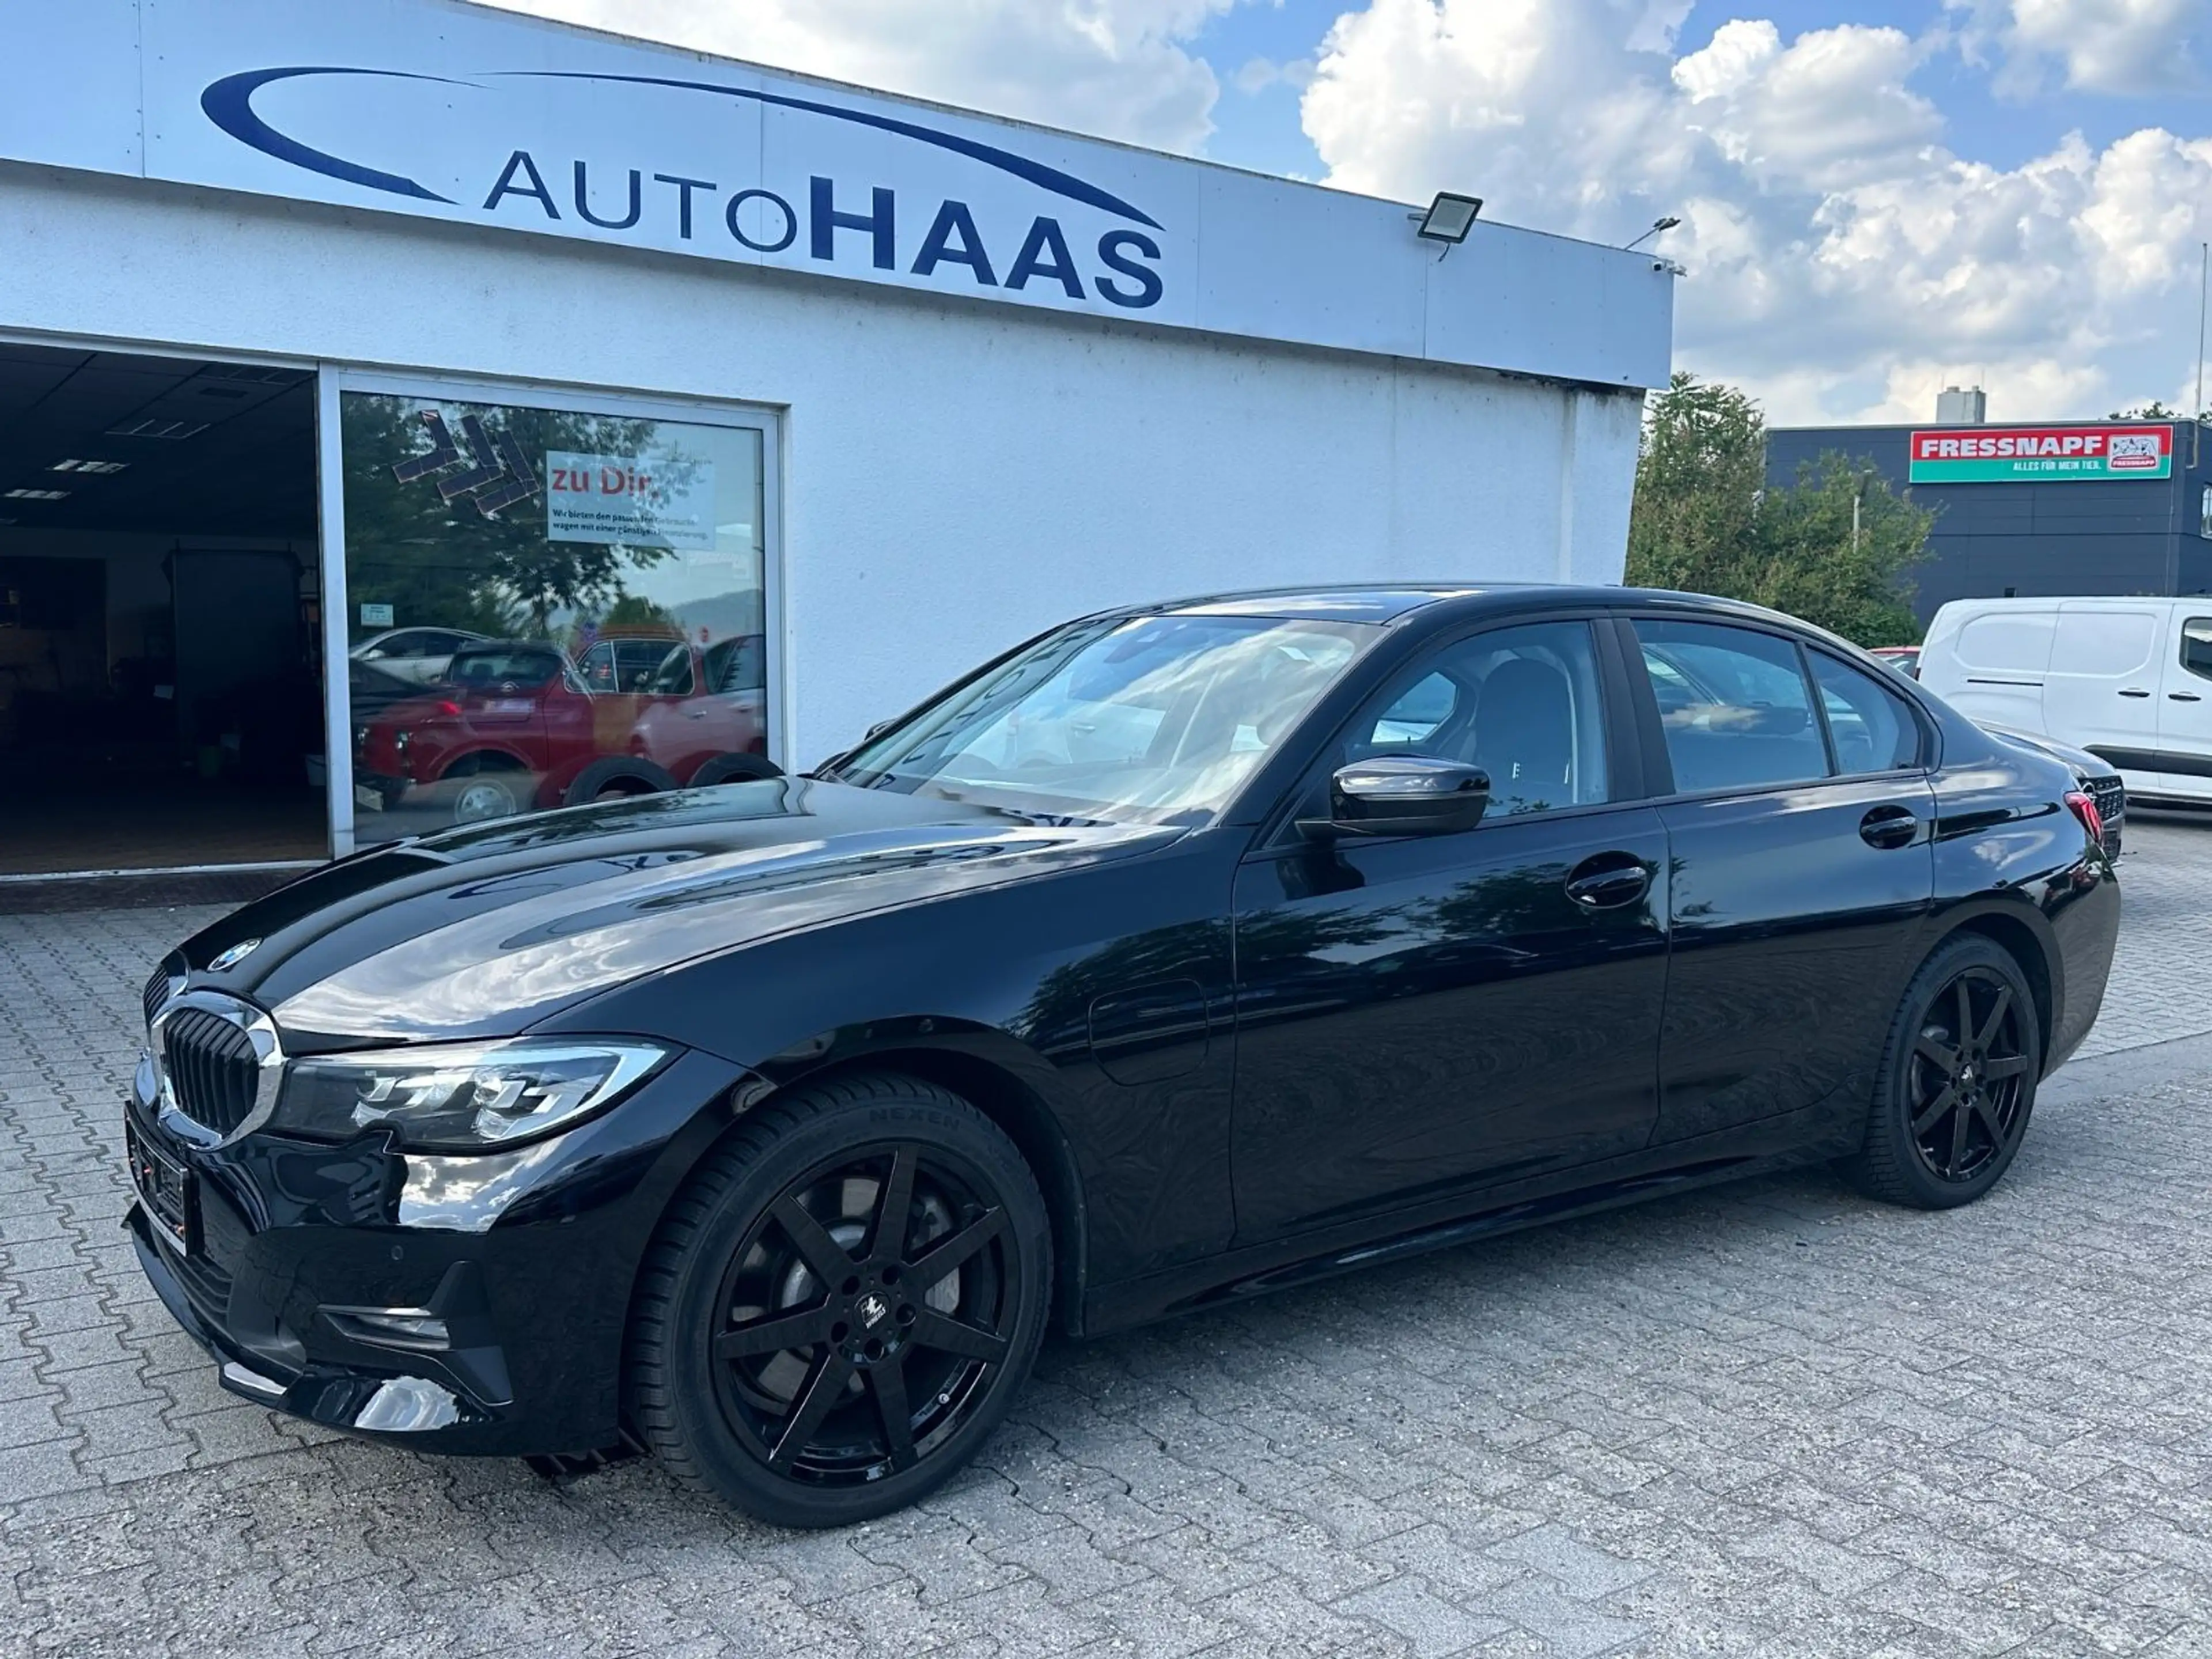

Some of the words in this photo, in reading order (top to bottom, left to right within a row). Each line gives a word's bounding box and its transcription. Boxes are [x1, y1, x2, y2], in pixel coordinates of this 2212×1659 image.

[1921, 435, 2103, 457] FRESSNAPF
[2013, 461, 2039, 471] ALLES
[2041, 459, 2056, 470] FÜR
[2058, 461, 2080, 470] MEIN
[552, 469, 589, 493] zu
[601, 466, 660, 500] Dir.
[552, 508, 567, 517] Wir
[567, 509, 594, 518] bieten
[596, 511, 611, 520] den
[552, 522, 579, 531] wagen
[869, 1107, 960, 1131] NEXEN
